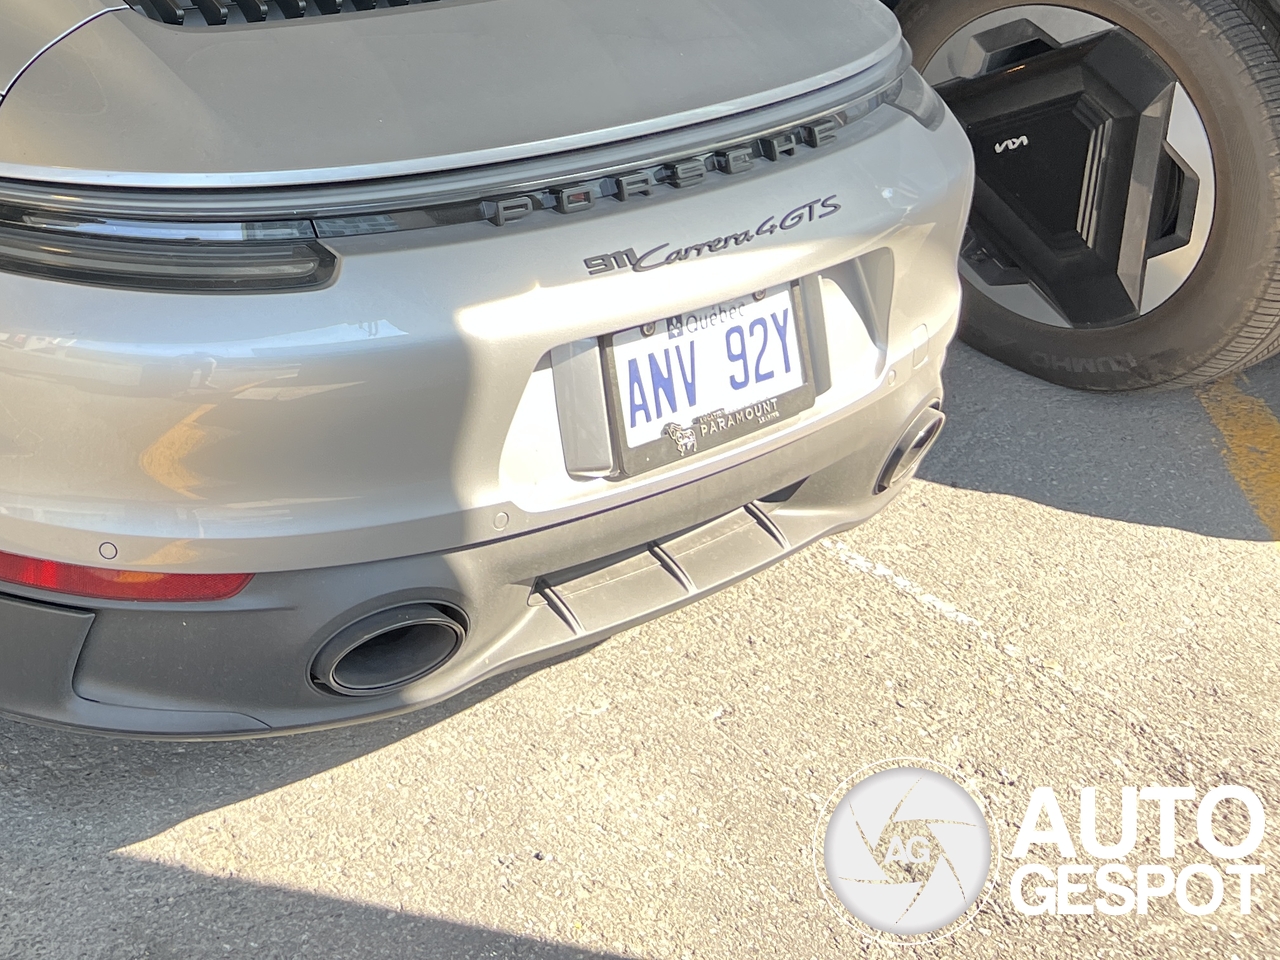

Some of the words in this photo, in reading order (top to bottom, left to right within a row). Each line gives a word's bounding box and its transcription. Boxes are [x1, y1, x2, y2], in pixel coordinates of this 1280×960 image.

[489, 119, 837, 227] PORSCHE
[583, 247, 638, 276] 911
[632, 229, 755, 273] Carrera
[755, 215, 778, 236] 4
[779, 194, 842, 231] GTS
[685, 301, 746, 334] Québec
[627, 340, 697, 428] ANV
[725, 308, 791, 391] 92Y
[700, 398, 778, 437] PARAMOUNT
